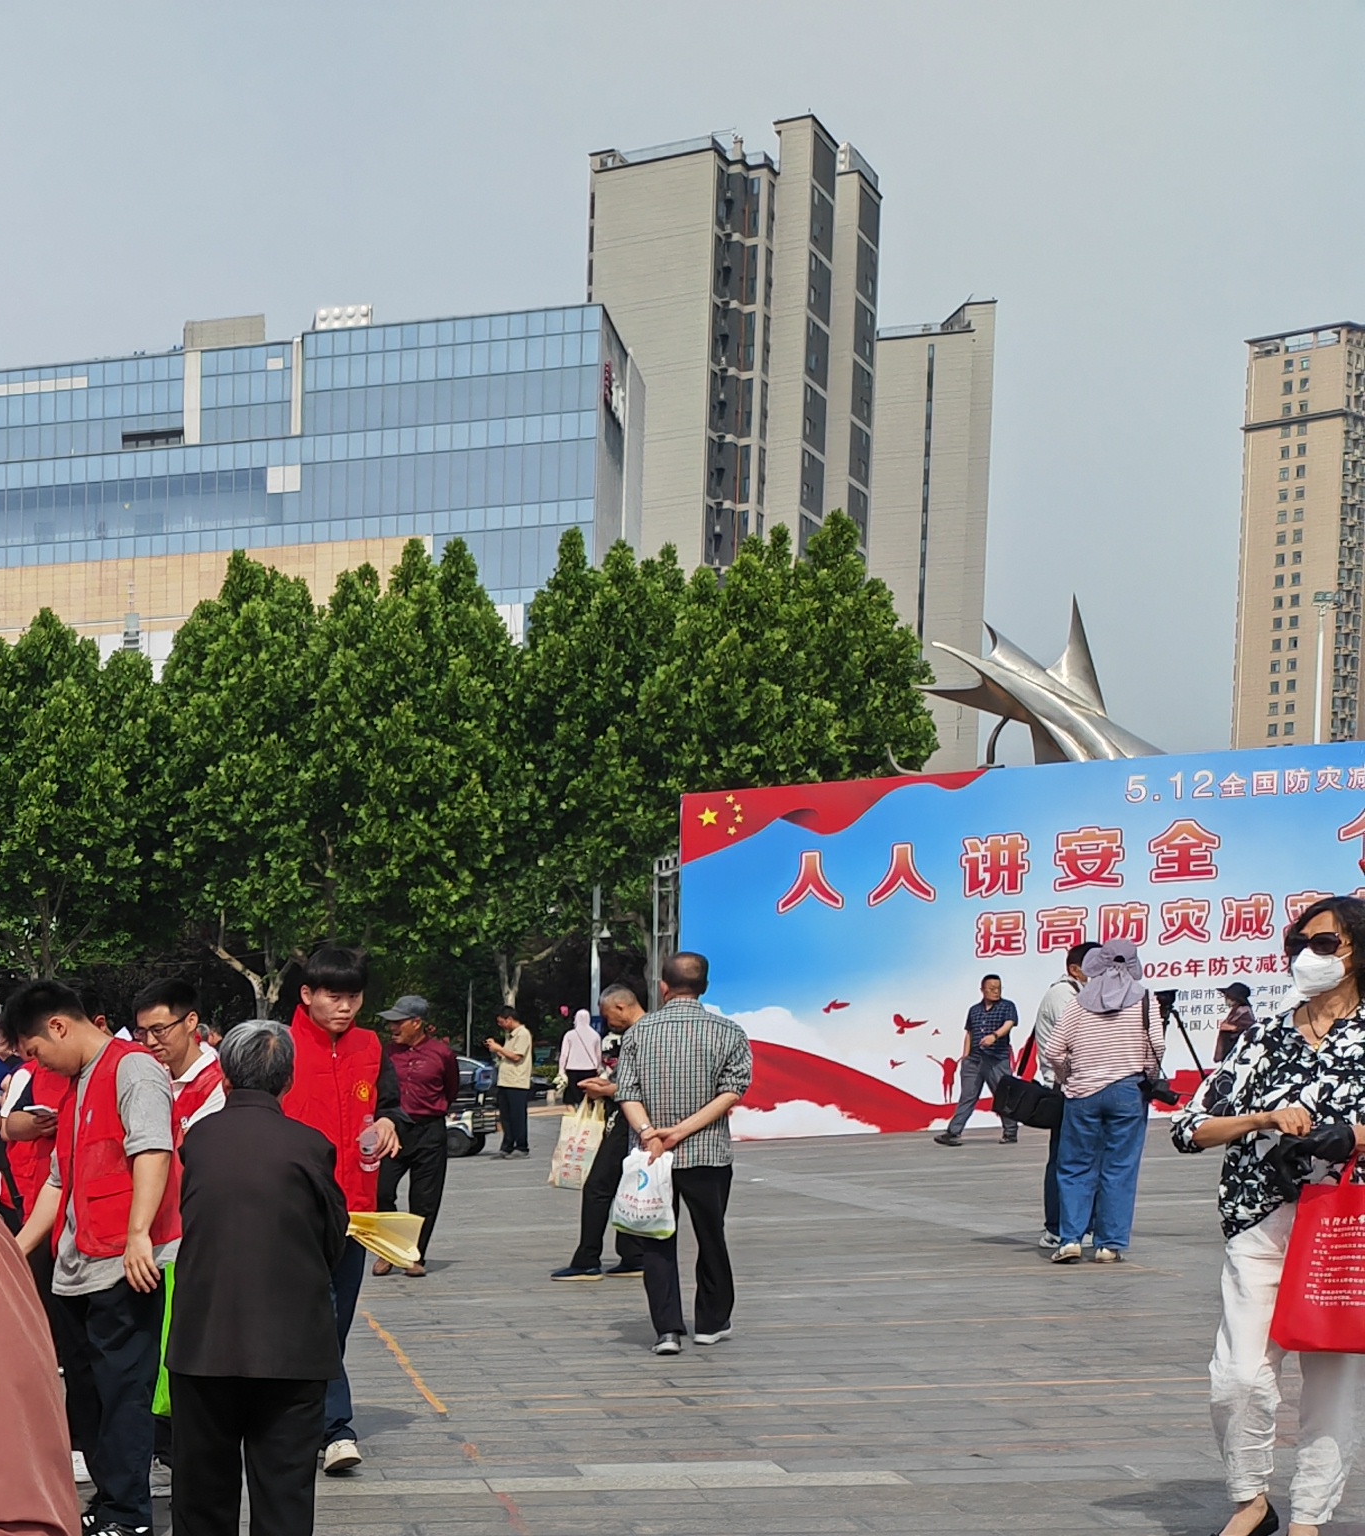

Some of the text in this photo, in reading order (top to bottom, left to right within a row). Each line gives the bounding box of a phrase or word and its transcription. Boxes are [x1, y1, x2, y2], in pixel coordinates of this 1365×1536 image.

[776, 818, 1221, 915] 人人讲安全
